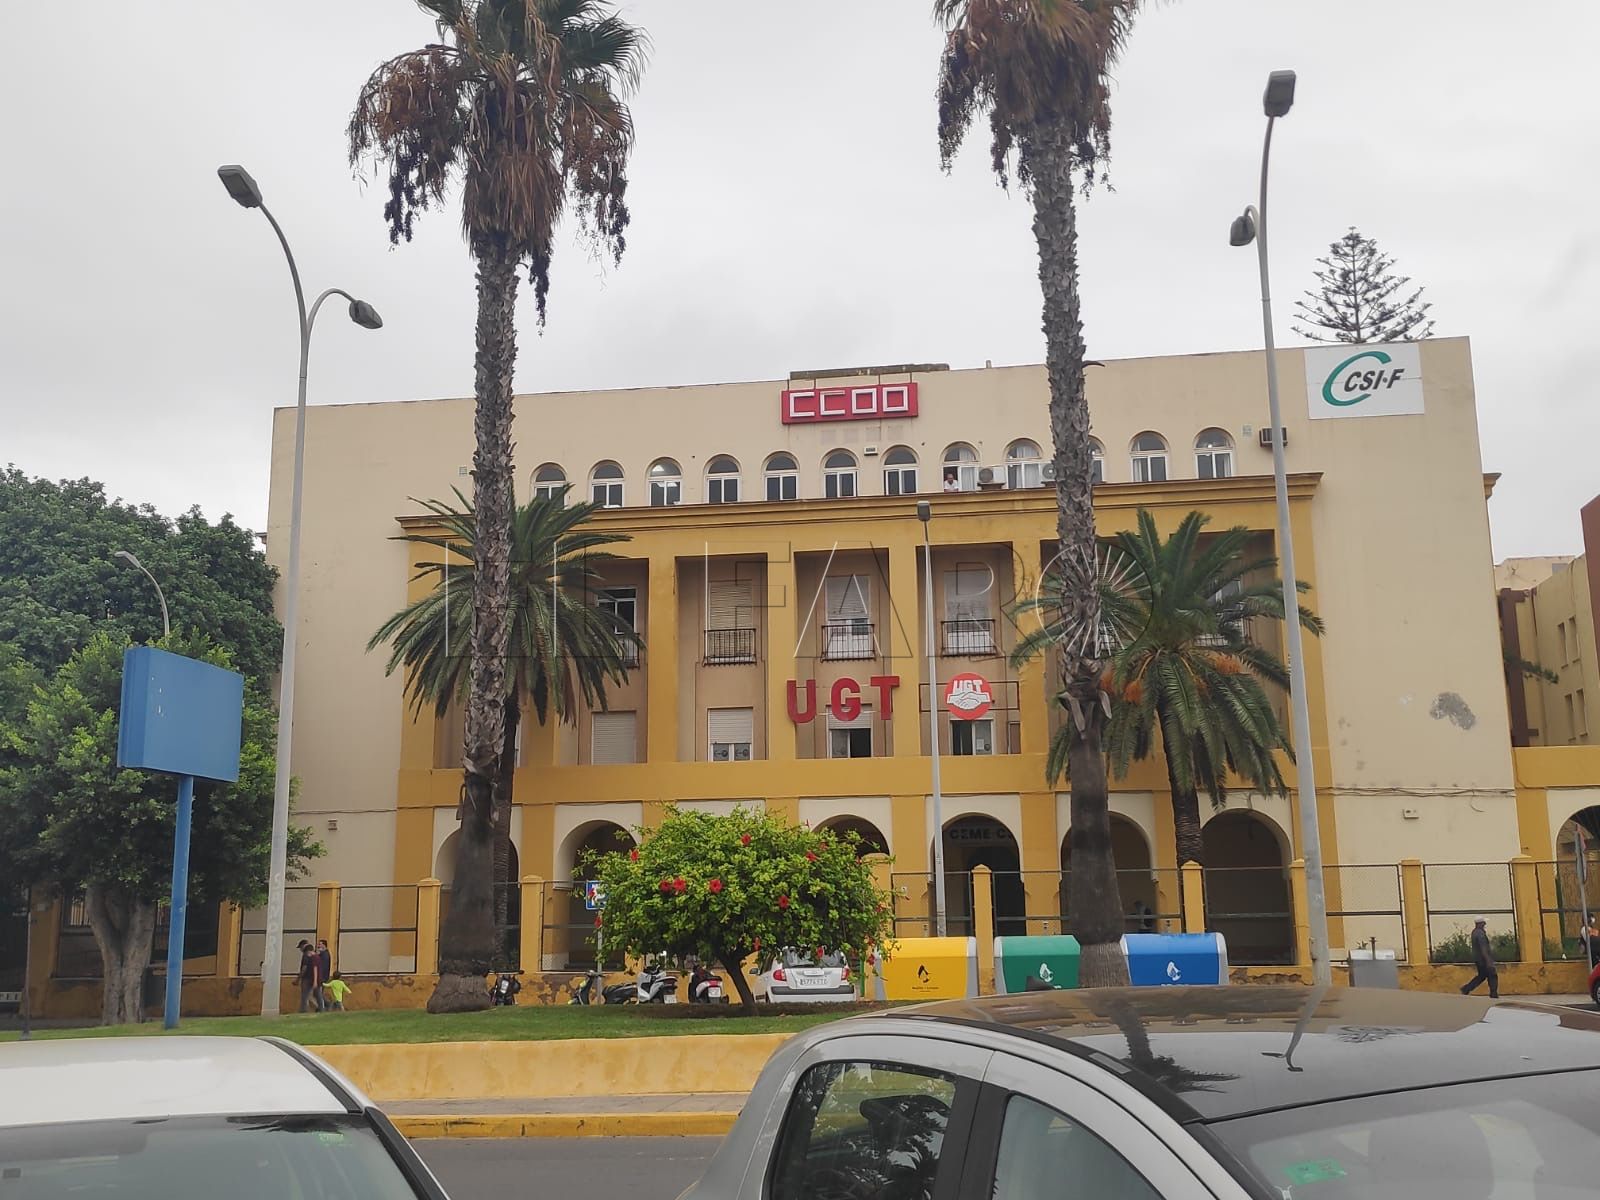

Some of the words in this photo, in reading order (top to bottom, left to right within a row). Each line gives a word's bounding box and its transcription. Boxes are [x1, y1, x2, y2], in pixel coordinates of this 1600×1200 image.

[789, 386, 909, 417] CCOO
[786, 675, 900, 724] UGT
[952, 679, 983, 694] UGT
